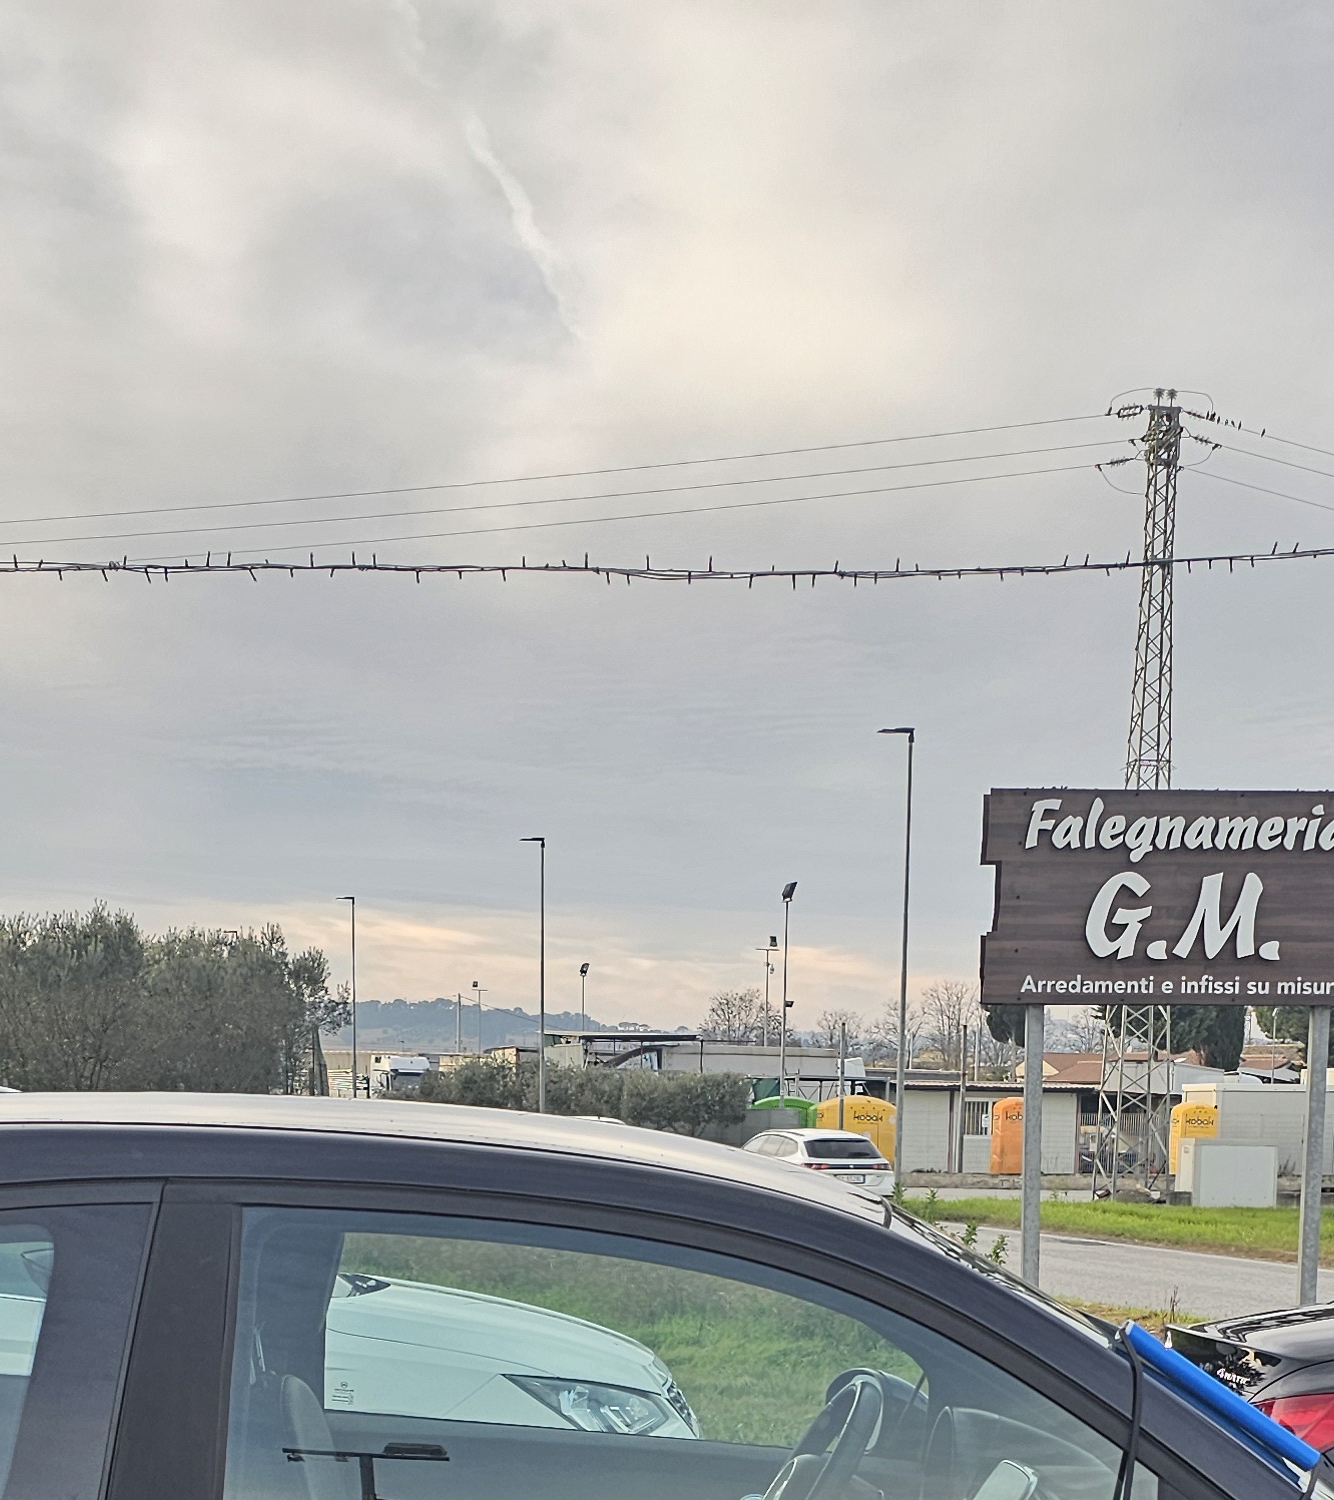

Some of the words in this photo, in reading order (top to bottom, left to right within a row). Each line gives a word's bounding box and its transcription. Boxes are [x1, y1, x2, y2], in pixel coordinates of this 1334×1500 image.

[1085, 871, 1281, 961] G.M.
[1020, 974, 1154, 995] Arredamenti
[1161, 979, 1173, 995] e
[1180, 975, 1240, 996] infissi
[1246, 979, 1270, 996] su
[1005, 1110, 1023, 1121] kob
